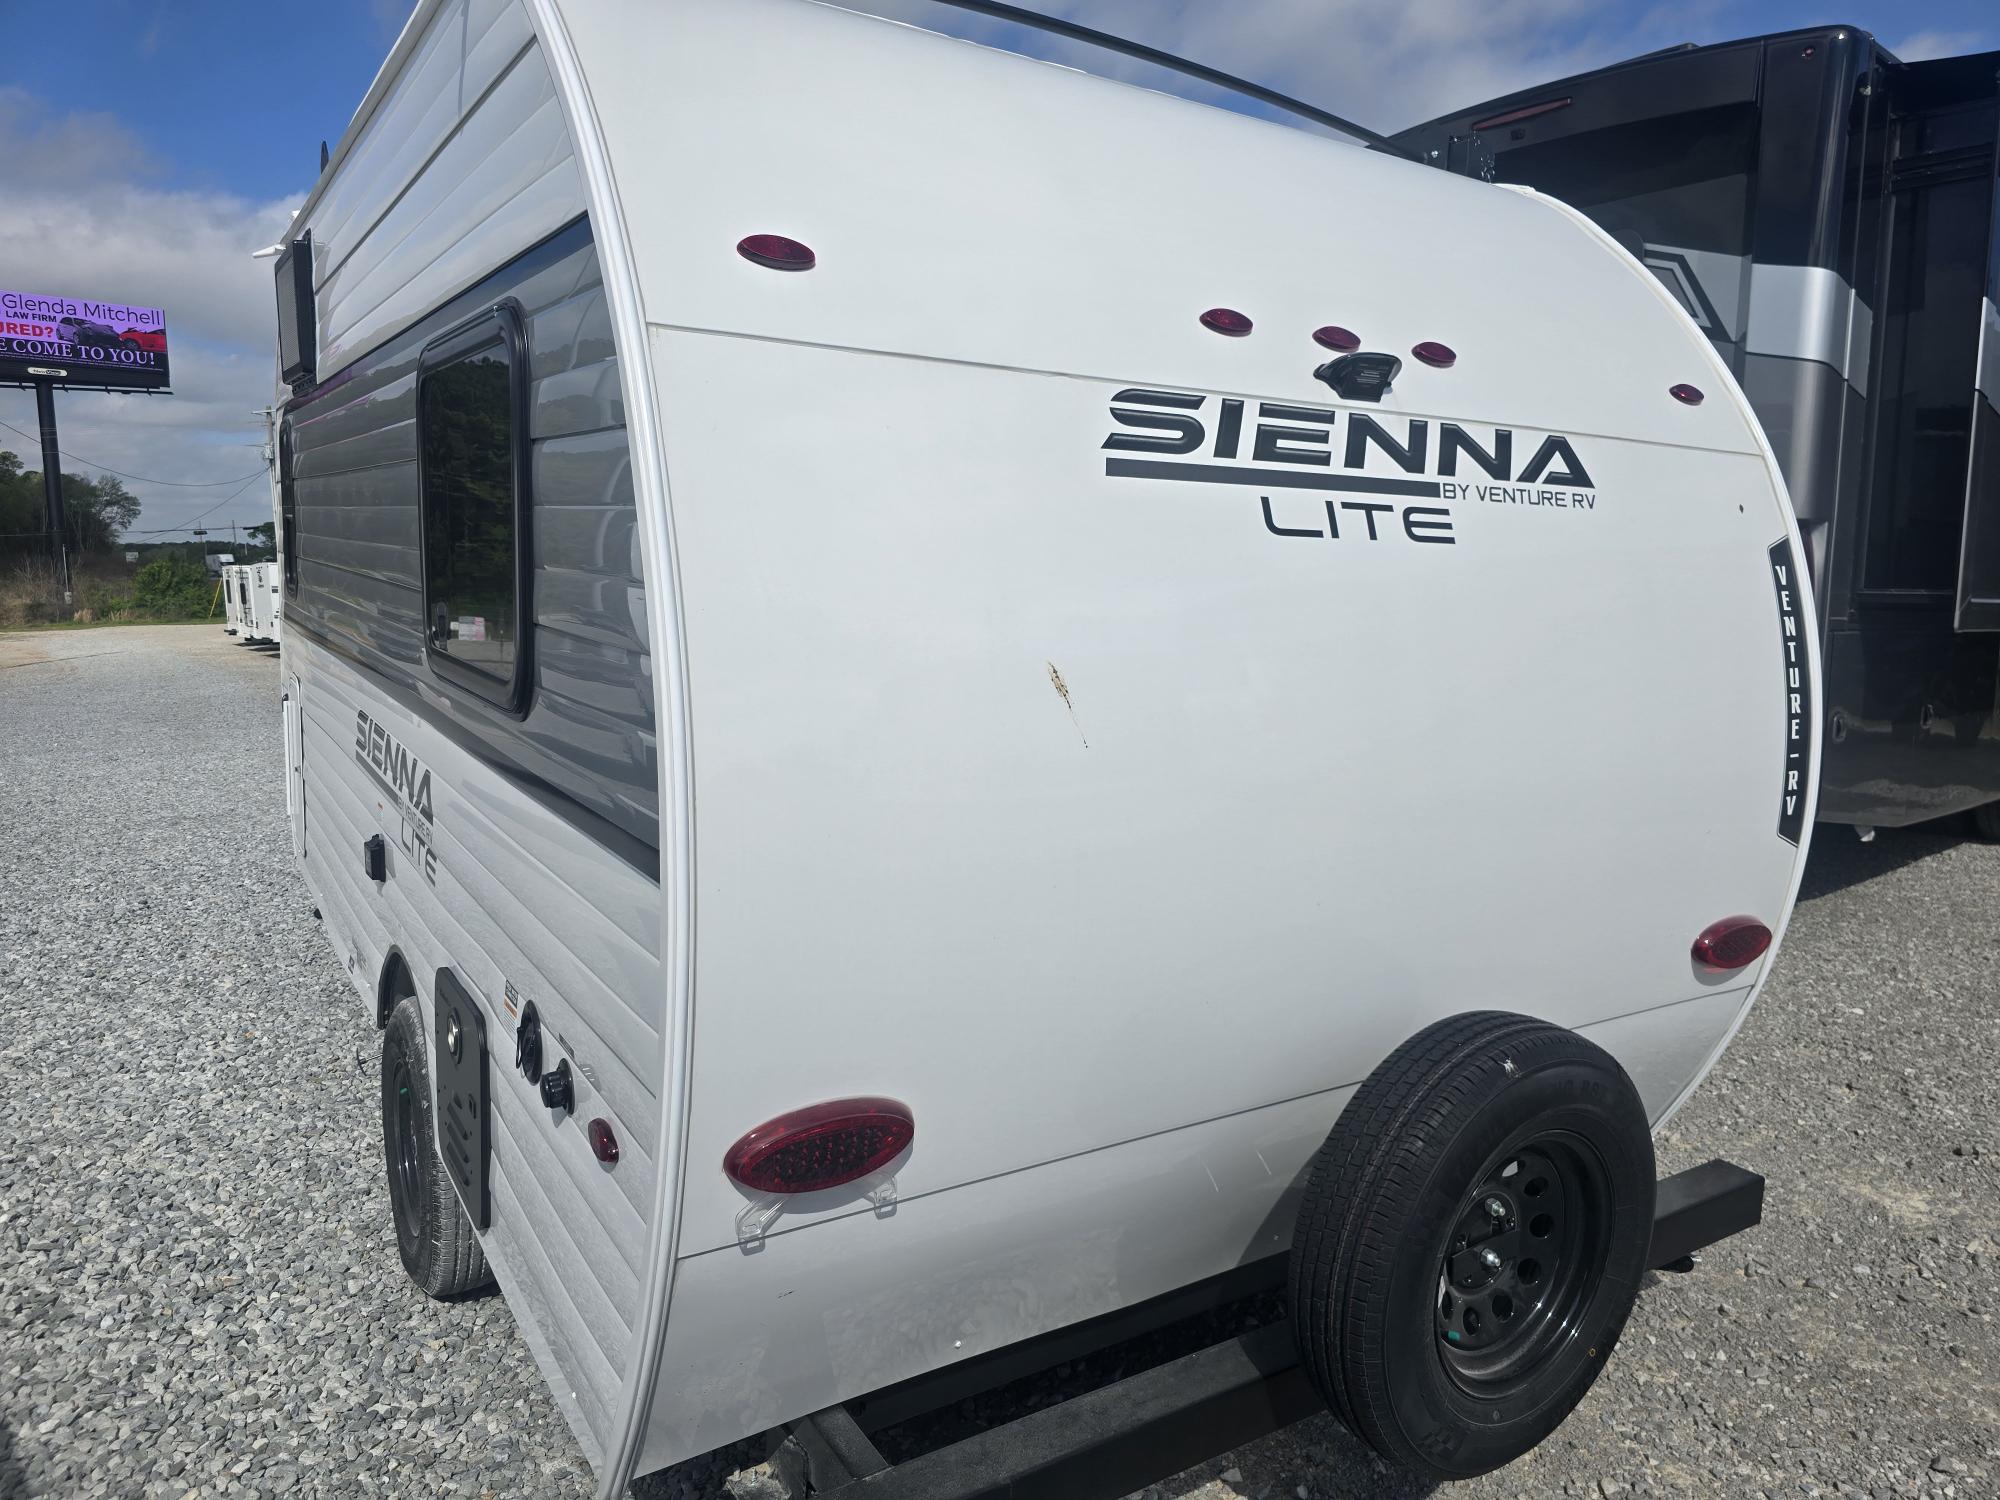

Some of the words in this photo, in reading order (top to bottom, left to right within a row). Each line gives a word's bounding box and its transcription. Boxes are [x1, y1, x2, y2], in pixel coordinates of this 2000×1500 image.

[2, 293, 77, 316] Glenda
[84, 302, 161, 326] Mitchell
[5, 310, 29, 320] LAW
[32, 313, 57, 323] FIRM
[12, 339, 73, 357] COME
[78, 345, 105, 360] TO
[108, 348, 155, 365] YOU!
[1101, 388, 1596, 489] SIENNA
[1443, 483, 1470, 499] BY
[1476, 486, 1567, 507] VENTURE
[1572, 494, 1596, 509] RV
[1260, 496, 1456, 545] LITE
[356, 709, 434, 827] SIENNA
[402, 816, 437, 888] LITE
